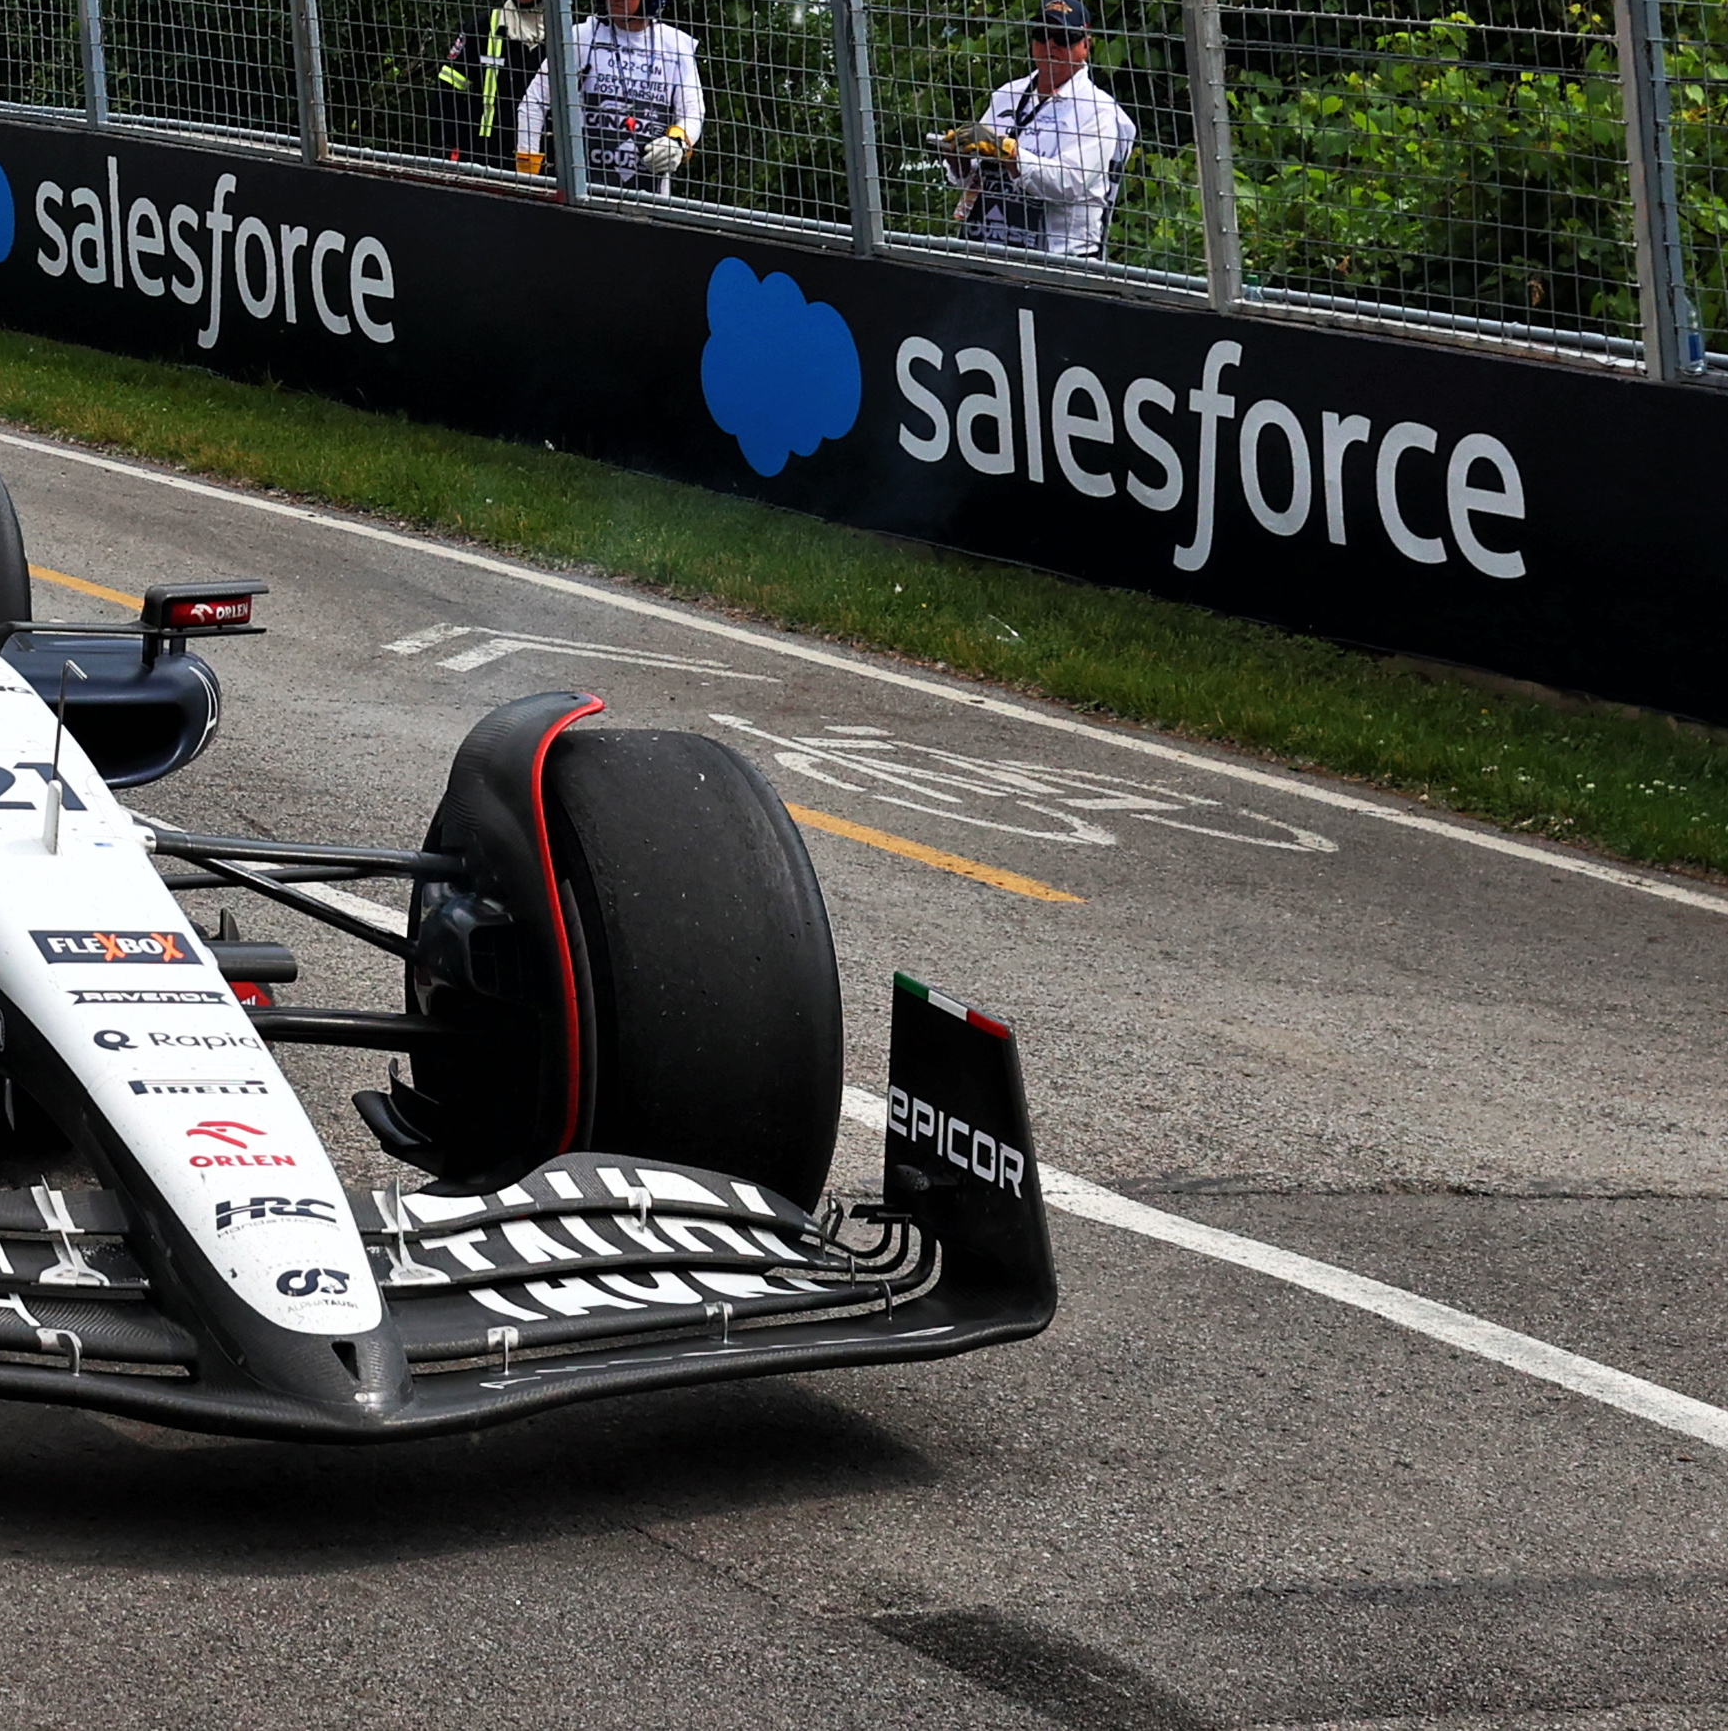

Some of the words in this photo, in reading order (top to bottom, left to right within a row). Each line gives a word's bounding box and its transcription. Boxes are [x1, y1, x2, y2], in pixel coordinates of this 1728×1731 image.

[591, 149, 647, 171] COUR
[35, 156, 396, 350] salesforce
[895, 307, 1527, 580] salesforce
[216, 602, 249, 620] ORLEN
[47, 932, 185, 962] FLEXBOX
[83, 992, 219, 1003] RAVENOL
[129, 1080, 269, 1096] PIRELLI
[888, 1085, 1025, 1199] EPICOR
[189, 1154, 297, 1167] ORLEN
[215, 1196, 337, 1231] HRC
